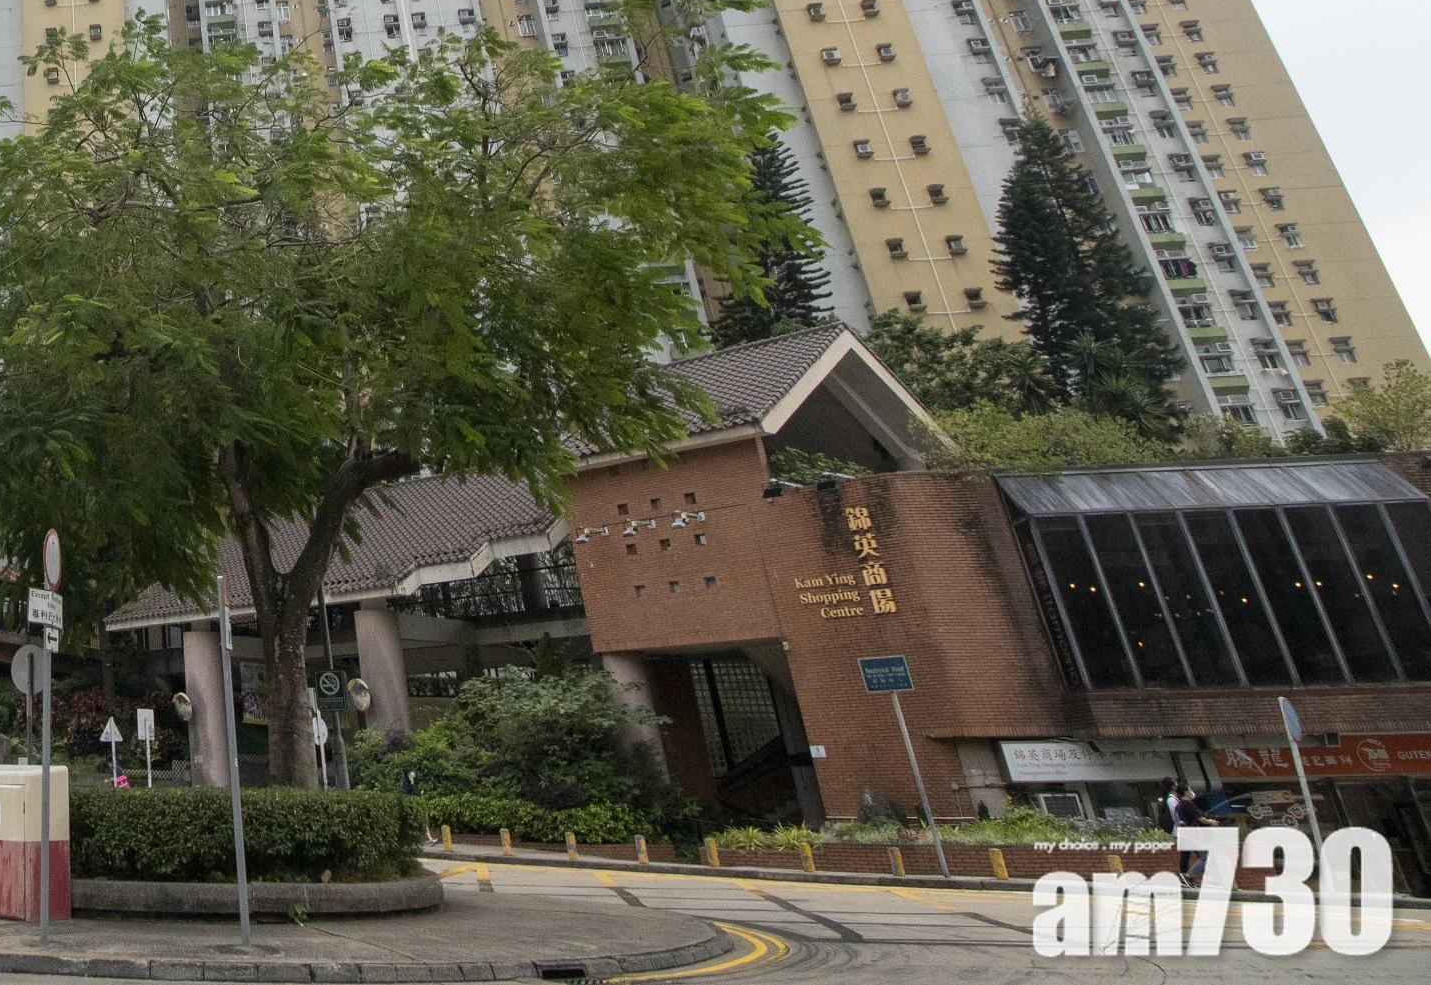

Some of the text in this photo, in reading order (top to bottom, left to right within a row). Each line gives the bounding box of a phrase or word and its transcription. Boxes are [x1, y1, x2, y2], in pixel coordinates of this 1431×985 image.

[845, 506, 897, 614] 錦英商場
[794, 573, 856, 589] Kam Ying
[799, 589, 861, 605] Shopping
[820, 606, 864, 618] Centre
